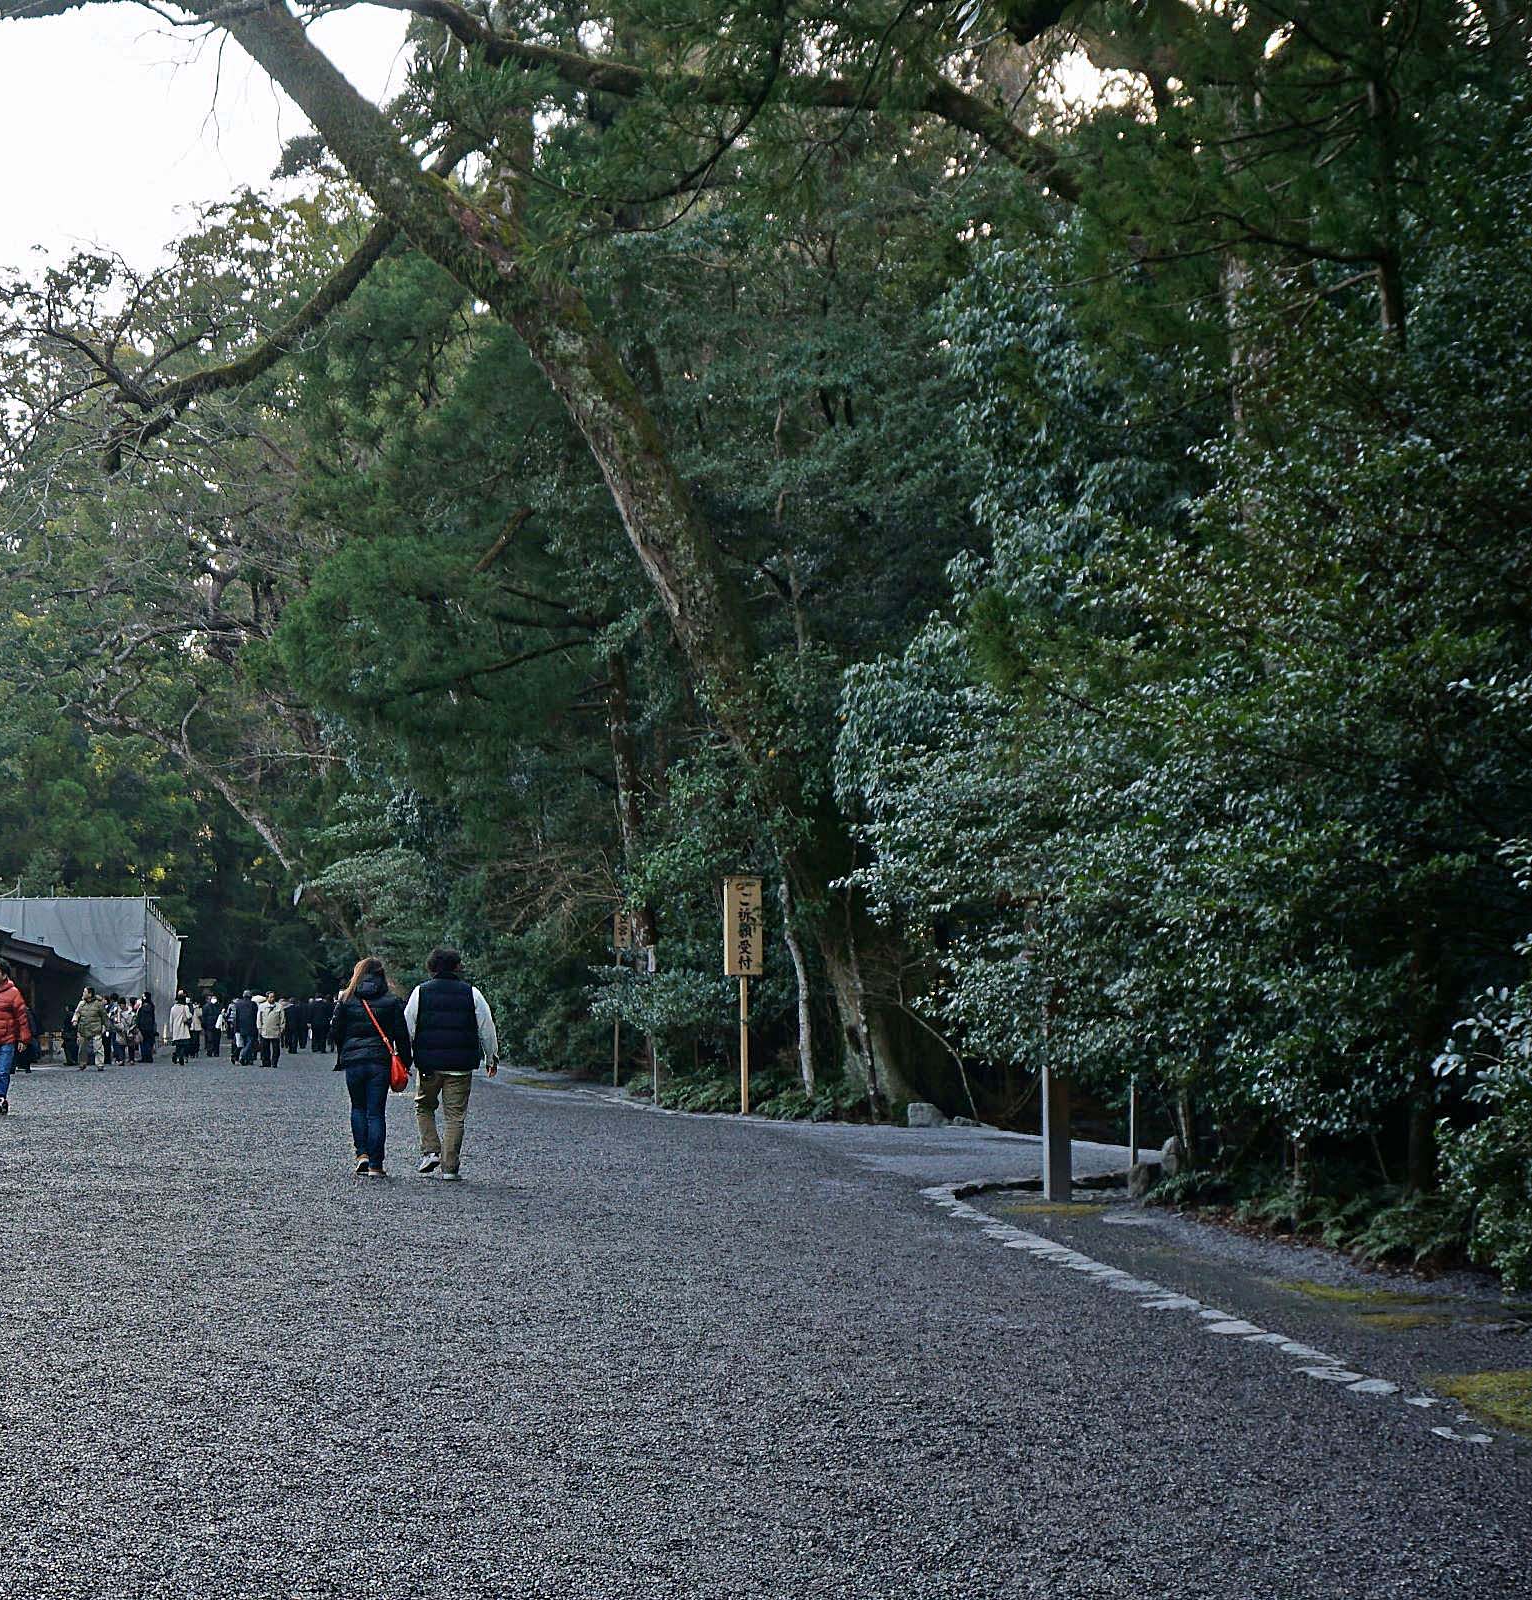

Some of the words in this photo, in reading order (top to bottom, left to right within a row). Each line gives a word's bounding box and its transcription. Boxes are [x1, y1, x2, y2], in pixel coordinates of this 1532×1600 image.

[738, 892, 753, 970] ご祈願受付
